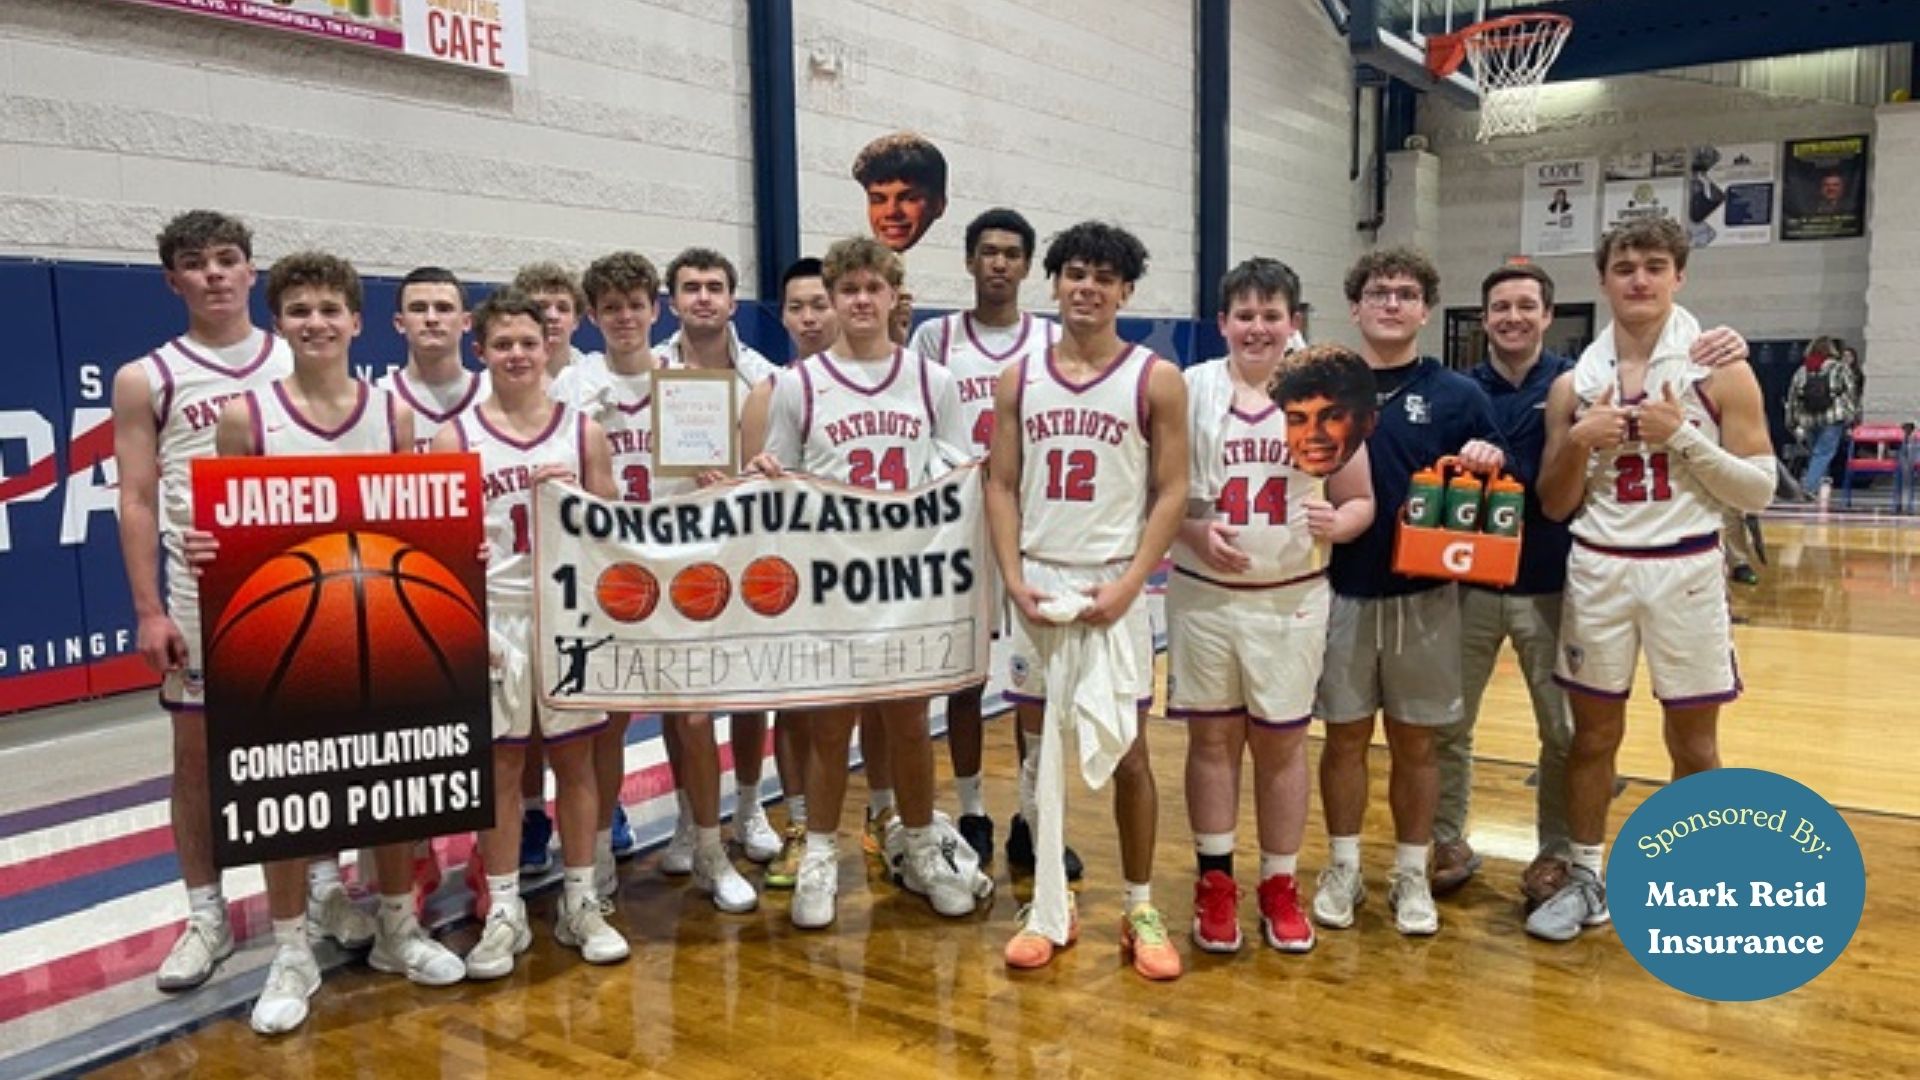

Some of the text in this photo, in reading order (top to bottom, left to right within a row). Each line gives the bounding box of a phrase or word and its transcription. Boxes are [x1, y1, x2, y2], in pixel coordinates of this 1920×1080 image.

[427, 10, 505, 68] CAFE
[825, 411, 922, 447] PATRIOTS
[1027, 410, 1128, 446] PATRIOTS
[622, 464, 651, 502] 3
[848, 448, 909, 493] 24
[1046, 450, 1096, 502] 12
[1614, 452, 1672, 502] 21
[214, 471, 469, 527] JARED WHITE
[560, 483, 961, 545] CONGRATULATIONS
[1215, 476, 1288, 525] 44
[1407, 497, 1424, 520] G
[1456, 503, 1477, 525] G
[1493, 506, 1514, 527] G
[811, 549, 975, 604] POINTS
[1442, 542, 1474, 573] G
[599, 632, 959, 693] JARED WHITE #12
[229, 722, 470, 782] CONGRATULATIONS
[221, 768, 481, 844] 1,000 POINTS!
